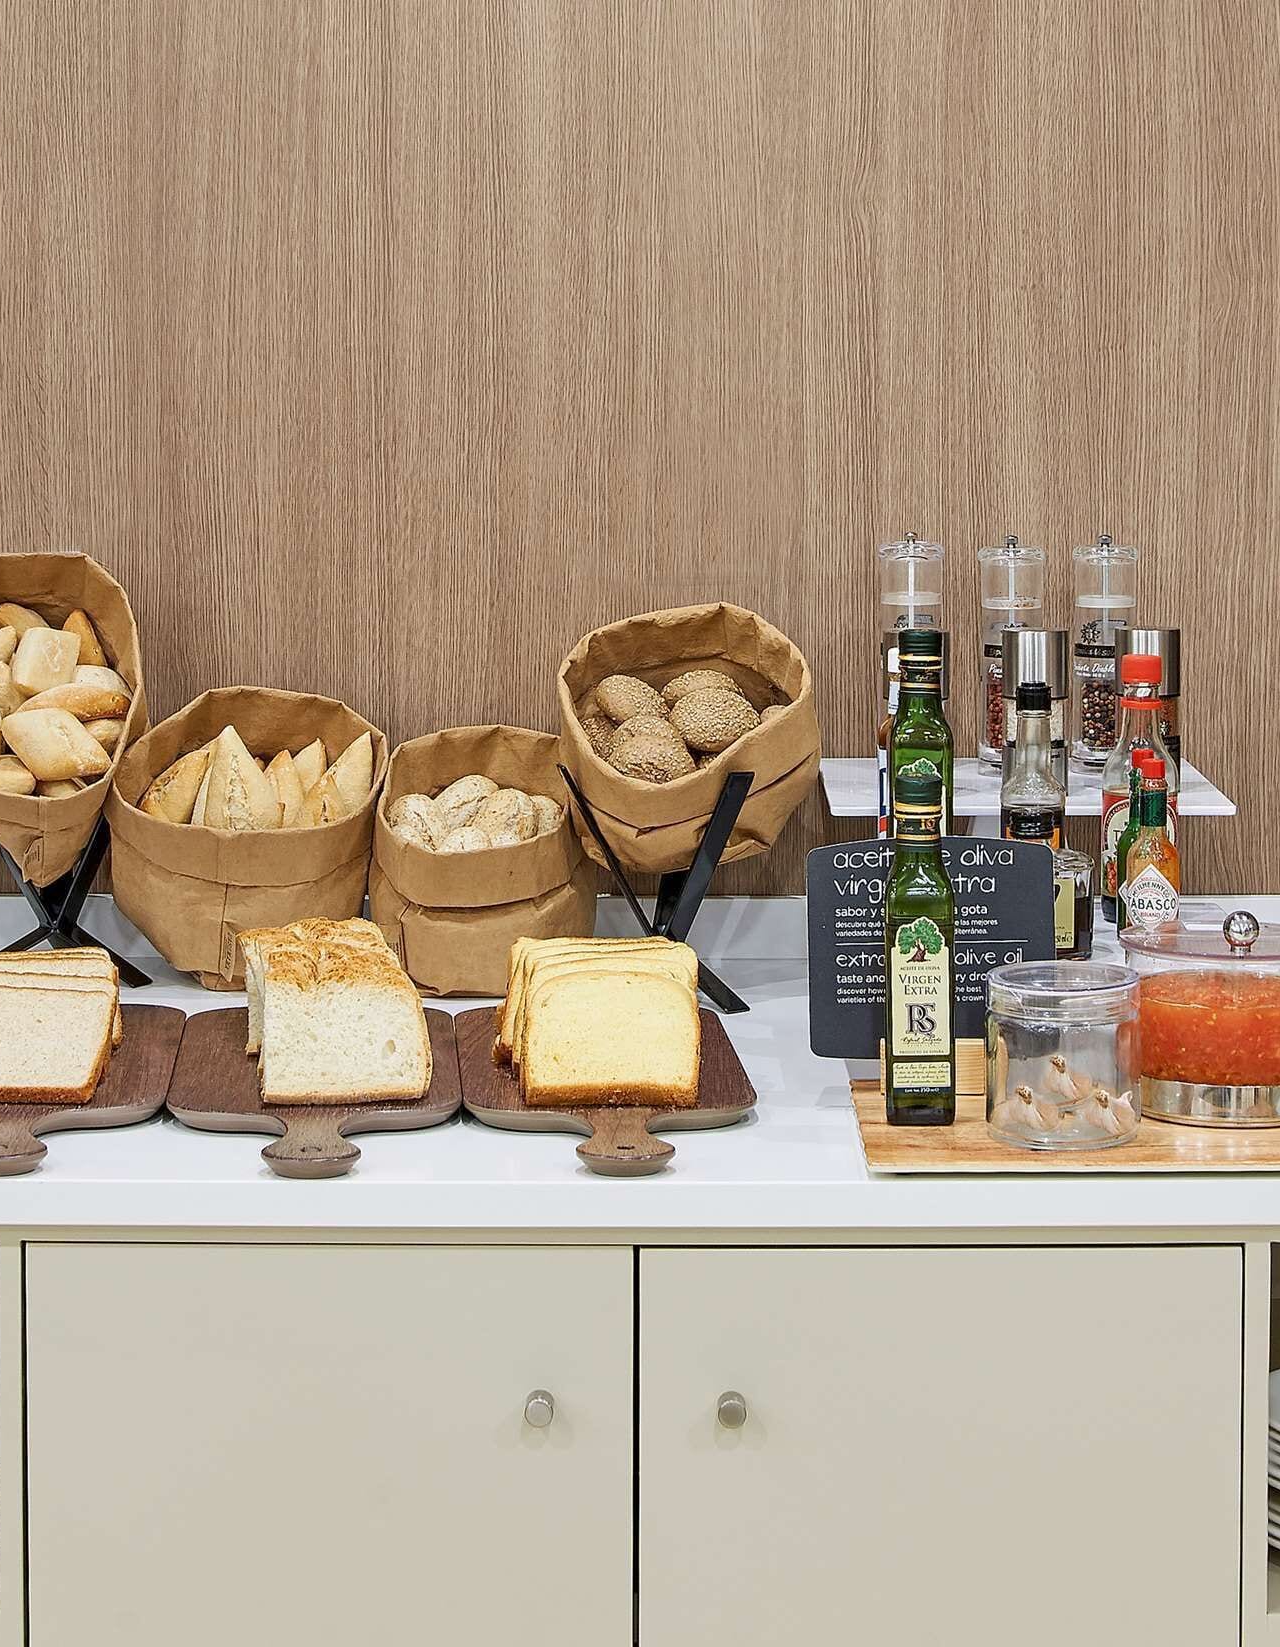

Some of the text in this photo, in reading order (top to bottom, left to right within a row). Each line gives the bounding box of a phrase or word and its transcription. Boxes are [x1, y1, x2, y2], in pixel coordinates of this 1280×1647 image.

[833, 846, 896, 868] aceit
[960, 844, 1014, 866] oliva
[834, 874, 886, 904] virg
[1128, 896, 1176, 910] TABASCO
[835, 906, 868, 917] sabor
[870, 908, 878, 918] y
[961, 905, 988, 916] gota
[835, 929, 872, 937] variedades
[954, 948, 996, 964] olive
[1004, 948, 1022, 964] oil
[837, 975, 864, 983] taste
[969, 971, 987, 981] dro
[899, 974, 941, 984] VIRGEN
[904, 984, 938, 995] EXTRA
